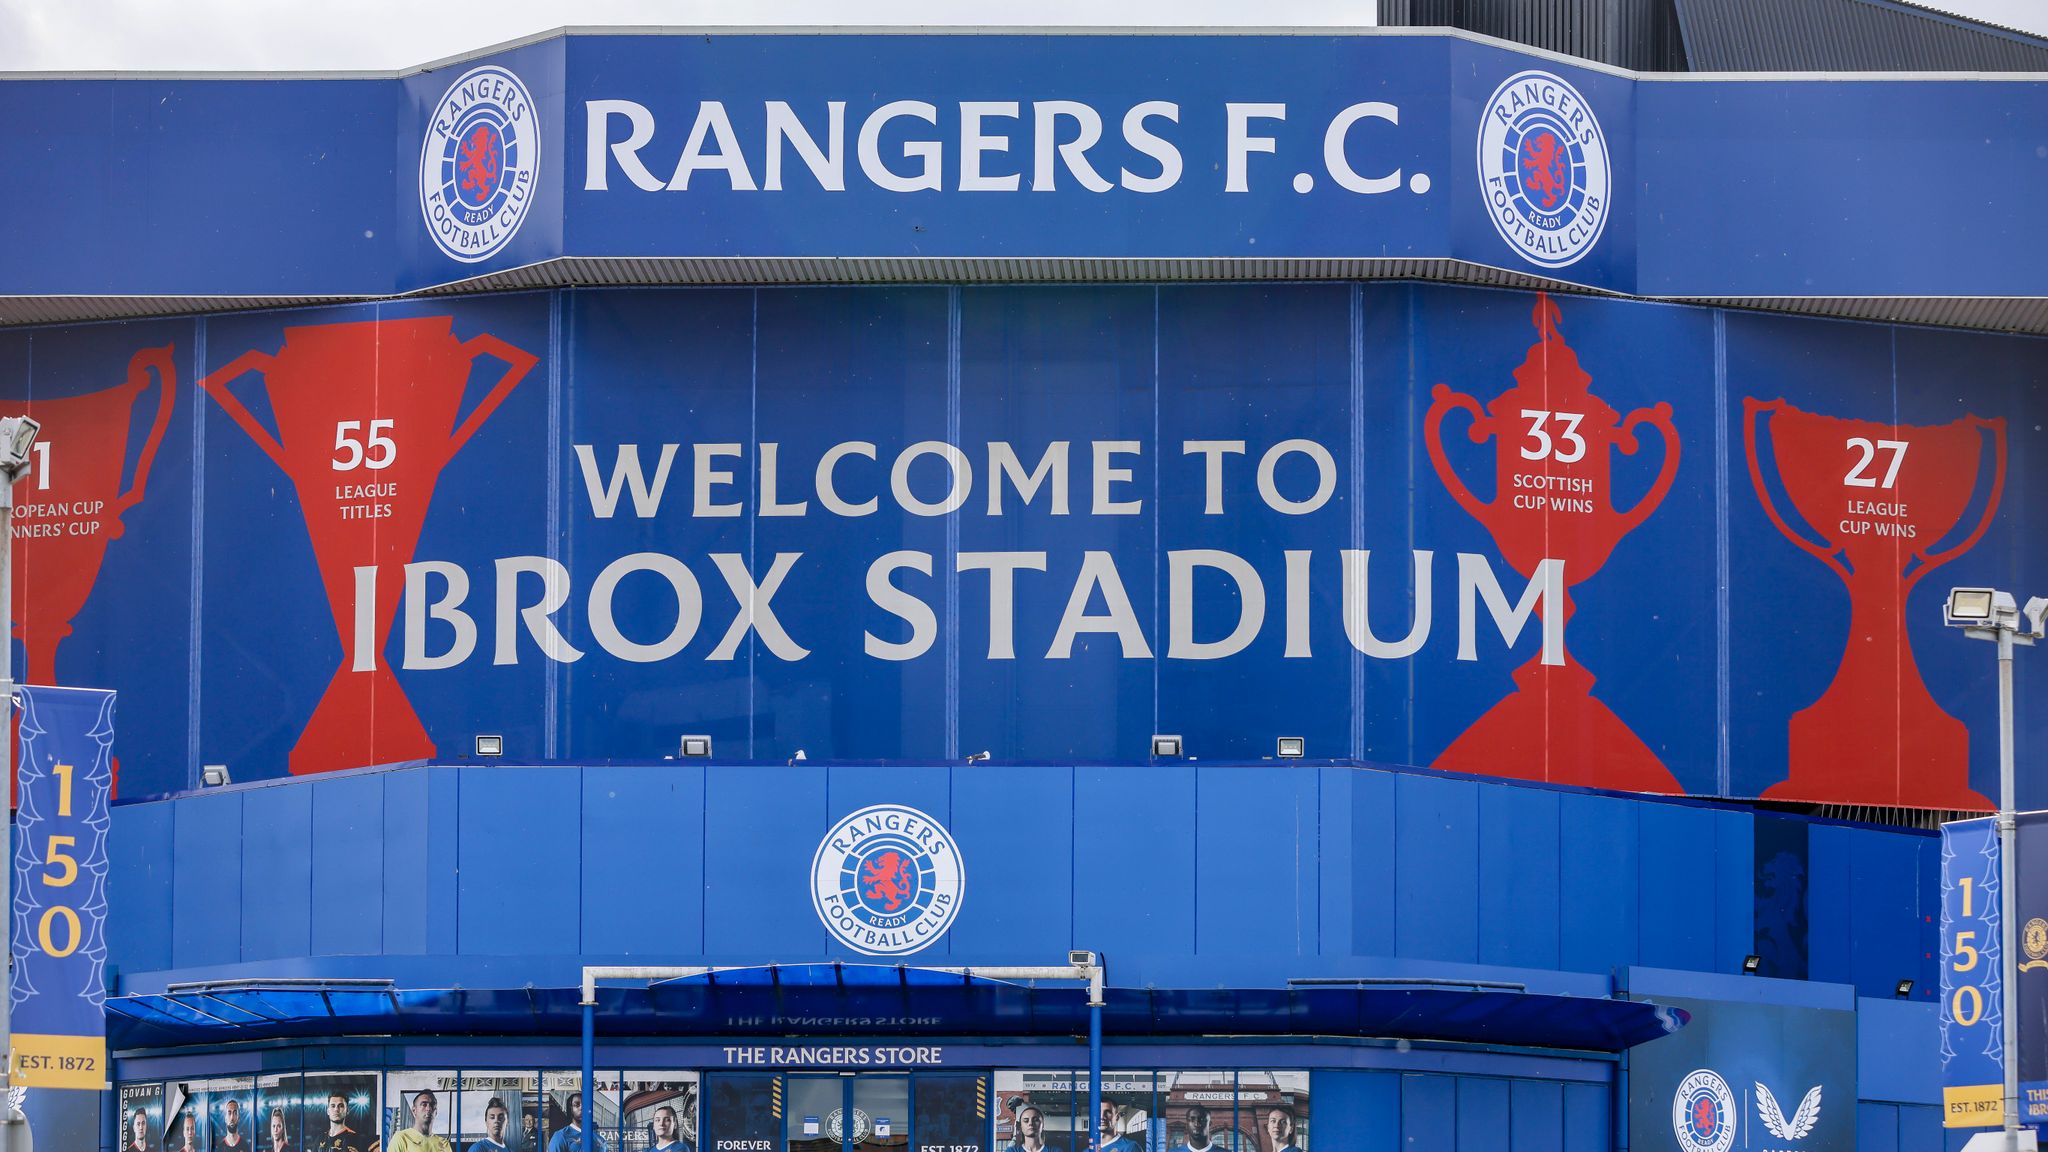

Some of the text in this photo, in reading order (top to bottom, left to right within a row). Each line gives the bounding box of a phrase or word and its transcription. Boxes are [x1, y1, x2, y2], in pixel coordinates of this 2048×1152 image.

[436, 78, 525, 139] RANGERS
[1495, 83, 1594, 145] RANGERS
[584, 100, 1431, 194] RANGERS F.C.
[430, 170, 530, 249] FOOTBALL CLUB
[464, 205, 494, 223] READY
[1489, 176, 1600, 254] FOOTBALL CLUB
[1529, 211, 1562, 228] READY
[332, 419, 397, 471] 55
[1520, 409, 1586, 463] 33
[33, 441, 51, 490] 1
[1844, 437, 1909, 488] 27
[573, 438, 1337, 518] WELCOME TO
[1513, 474, 1593, 493] SCOTTISH
[336, 482, 397, 499] LEAGUE
[73, 500, 104, 516] CUP
[340, 503, 392, 519] TITLES
[1513, 495, 1594, 513] CUP WINS
[1848, 500, 1908, 517] LEAGUE
[69, 521, 100, 536] CUP
[1840, 520, 1916, 538] CUP WINS
[352, 549, 1566, 672] IBROX STADIUM
[831, 814, 946, 855] RANGERS
[824, 893, 951, 947] FOOTBALL CLUB
[869, 914, 908, 927] READY
[20, 1055, 95, 1071] EST. 1872
[724, 1047, 942, 1064] THE RANGERS STORE
[123, 1087, 152, 1099] GOVAN
[1681, 1075, 1728, 1101] RANGERS
[1951, 1101, 1997, 1113] EST. 1872
[717, 1140, 771, 1151] FOREVER
